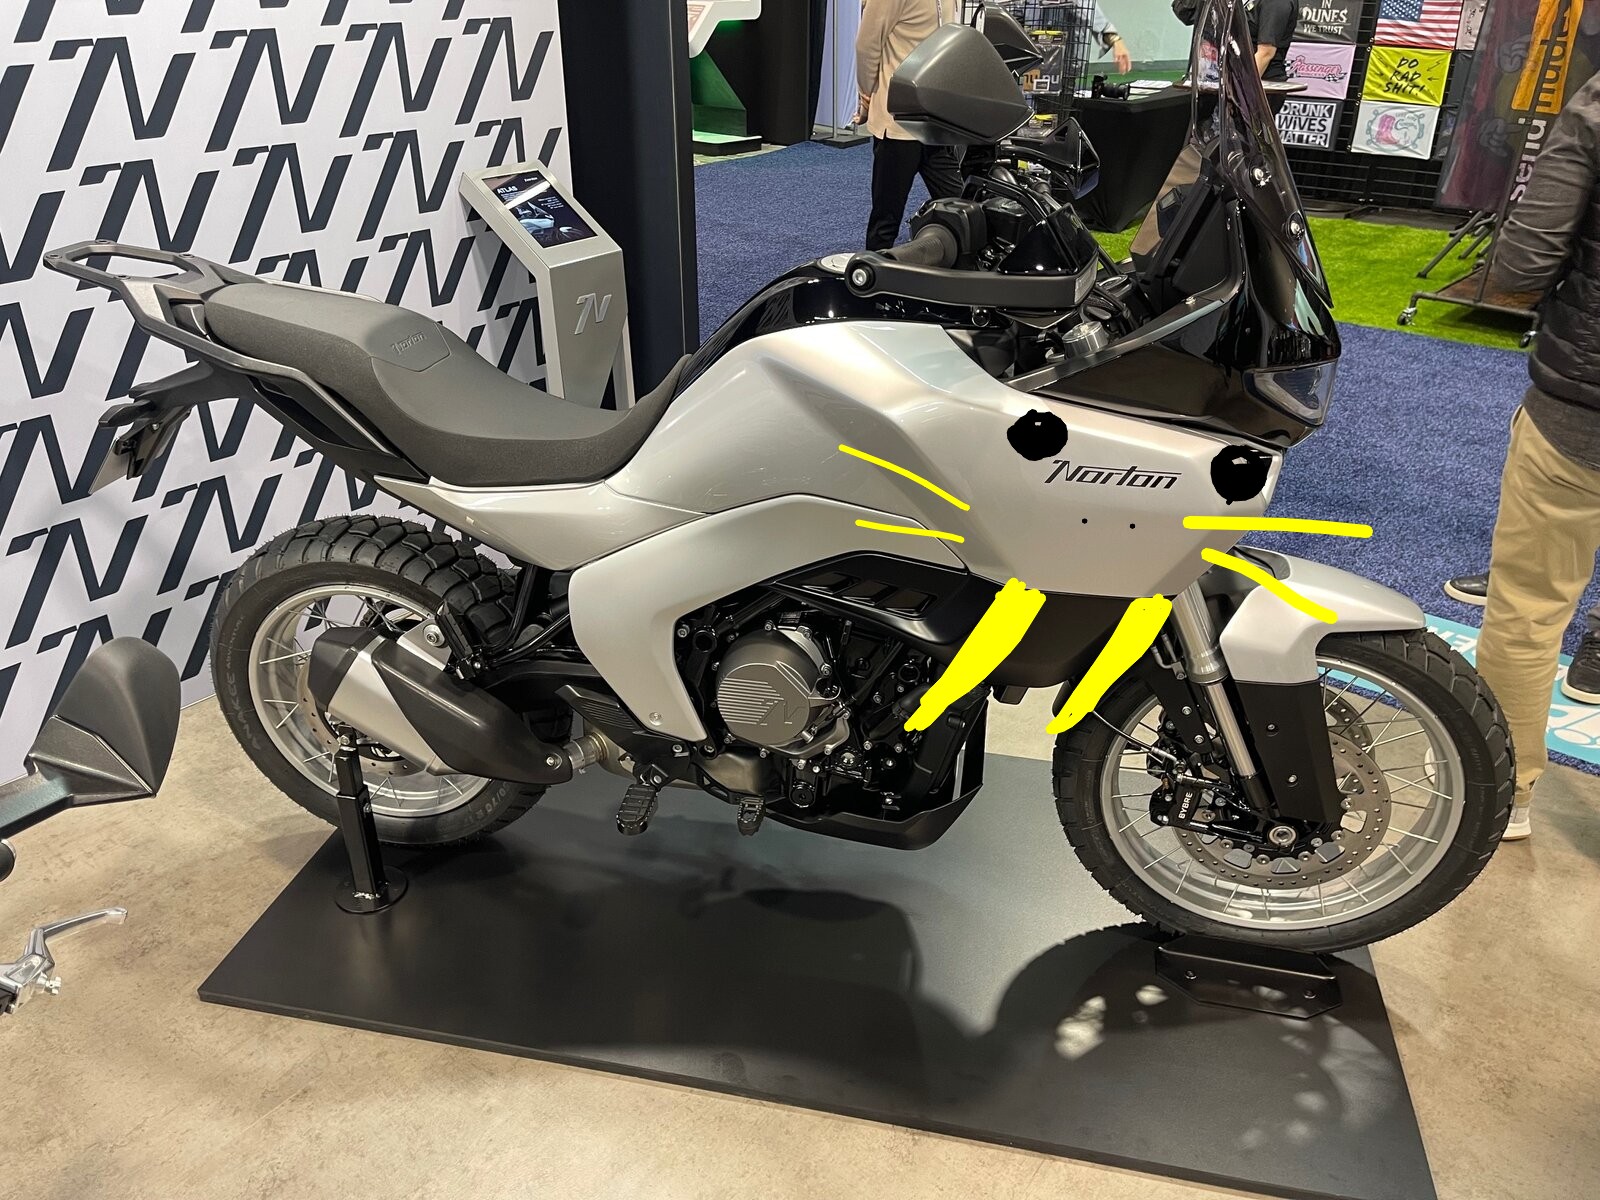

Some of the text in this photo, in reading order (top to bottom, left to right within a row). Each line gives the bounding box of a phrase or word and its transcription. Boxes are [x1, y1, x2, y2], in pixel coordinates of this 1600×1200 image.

[1303, 23, 1344, 35] WE TRUST
[1397, 56, 1419, 69] DO
[1390, 70, 1421, 82] RAD
[1383, 81, 1425, 96] SHIT!
[1280, 102, 1331, 118] DRUNK
[497, 185, 518, 194] ATLAS
[1044, 459, 1183, 490] Norton
[1178, 792, 1193, 819] BYBRE
